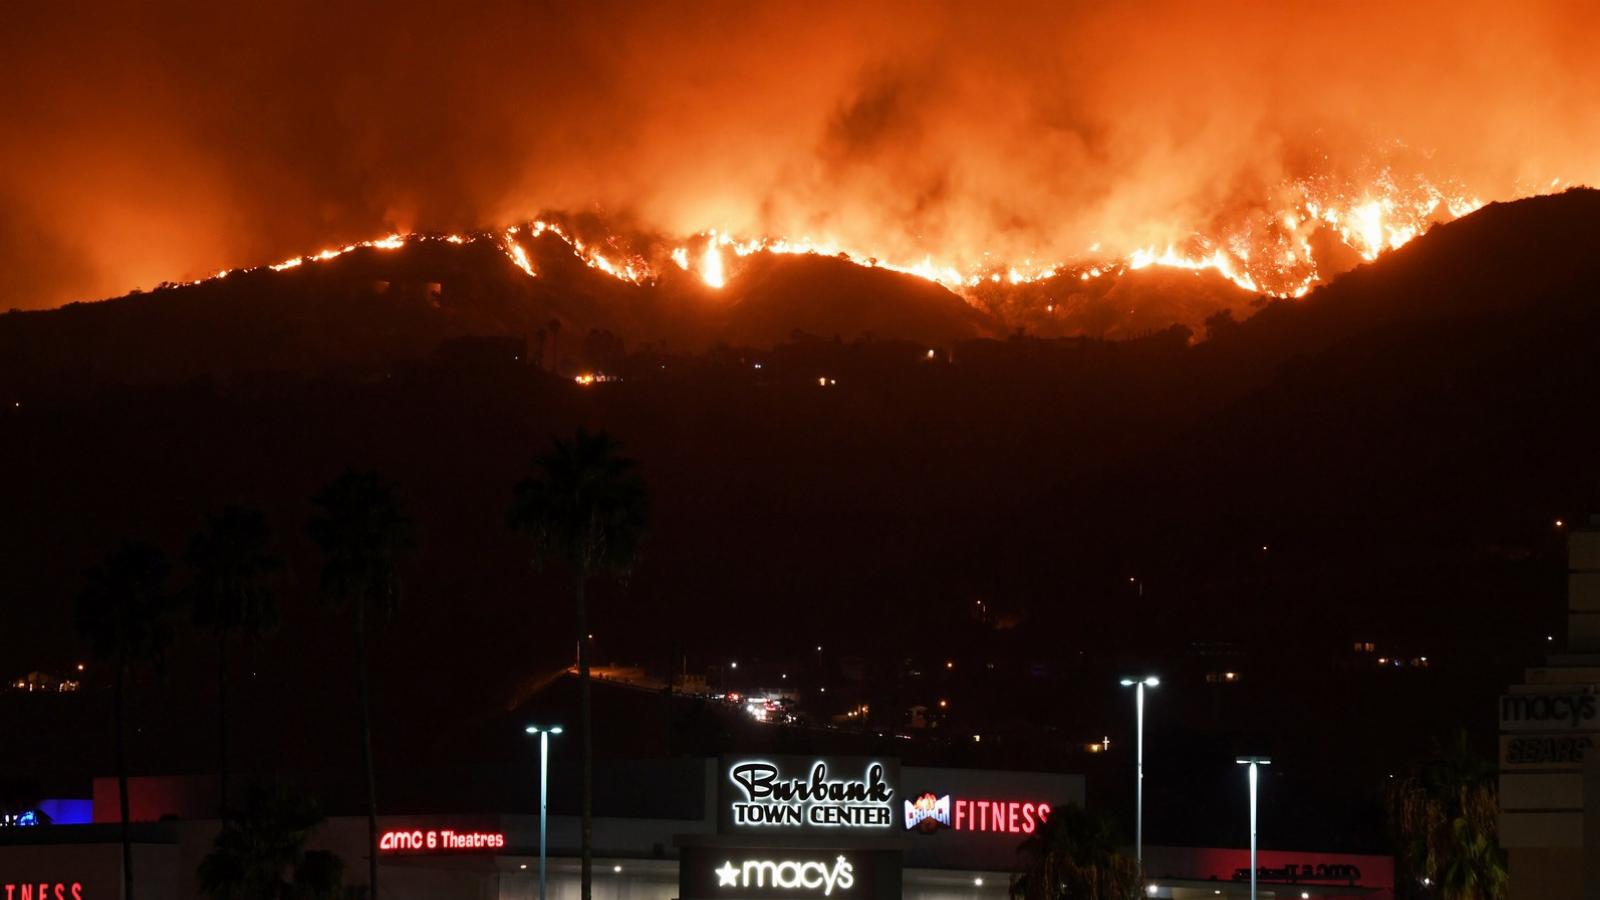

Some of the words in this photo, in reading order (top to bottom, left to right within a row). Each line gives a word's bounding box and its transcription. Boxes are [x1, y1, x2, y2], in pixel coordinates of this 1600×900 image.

[732, 762, 893, 802] Burbank
[735, 804, 801, 824] TOWN
[810, 805, 891, 825] CENTER
[426, 831, 437, 849] 6
[440, 831, 504, 848] Theatres
[742, 855, 854, 896] macy's
